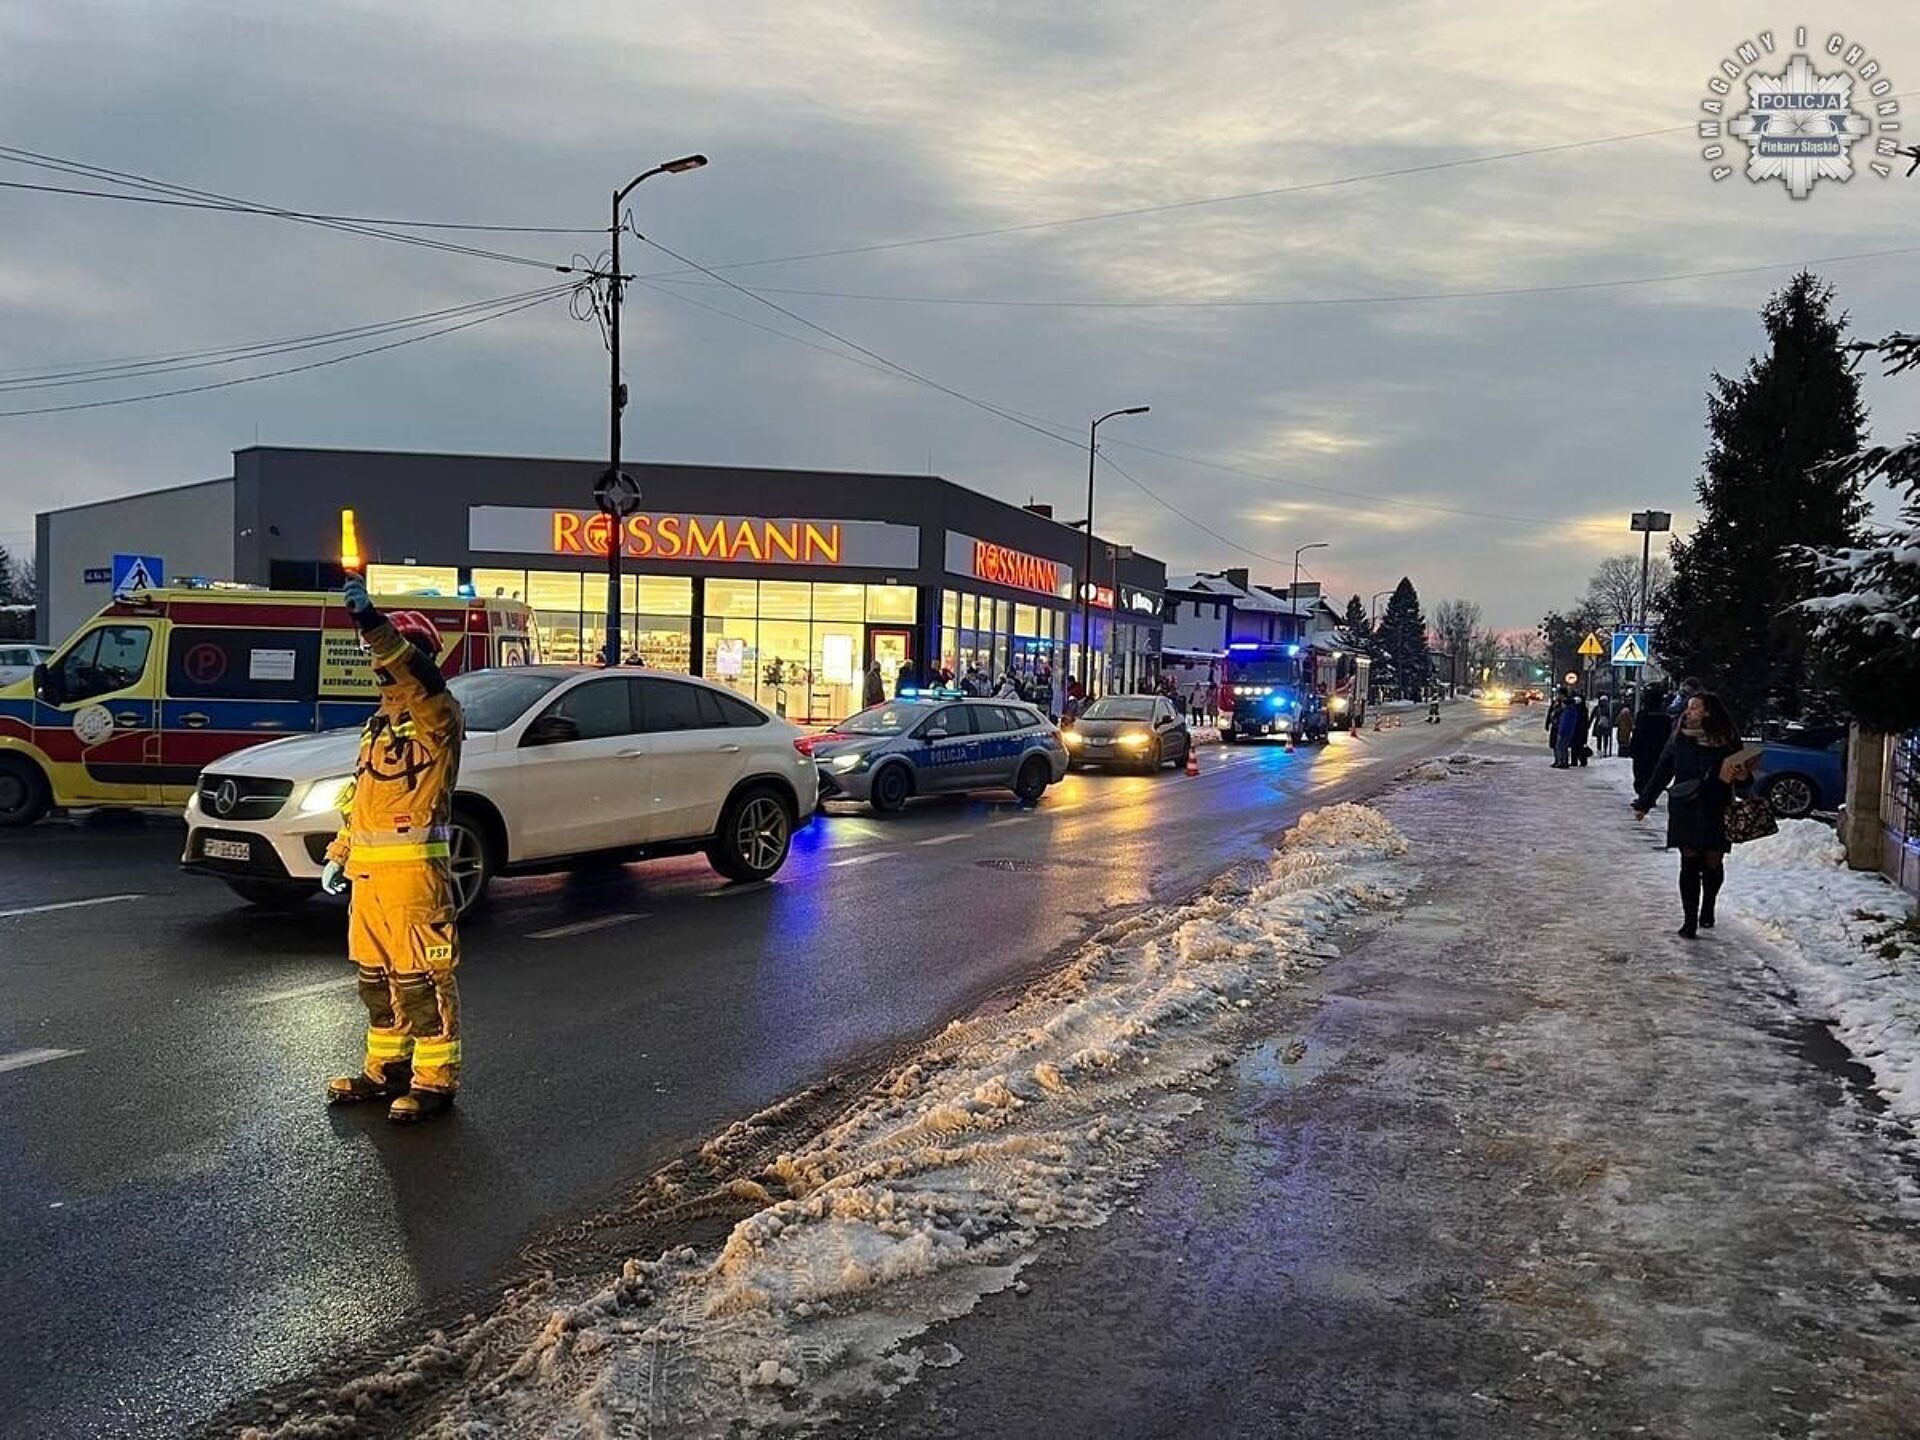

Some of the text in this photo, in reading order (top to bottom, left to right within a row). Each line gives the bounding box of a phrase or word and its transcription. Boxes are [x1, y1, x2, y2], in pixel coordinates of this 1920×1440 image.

[552, 511, 839, 563] ROSSMANN
[974, 541, 1057, 593] ROSSMANN
[429, 948, 449, 958] PSP
